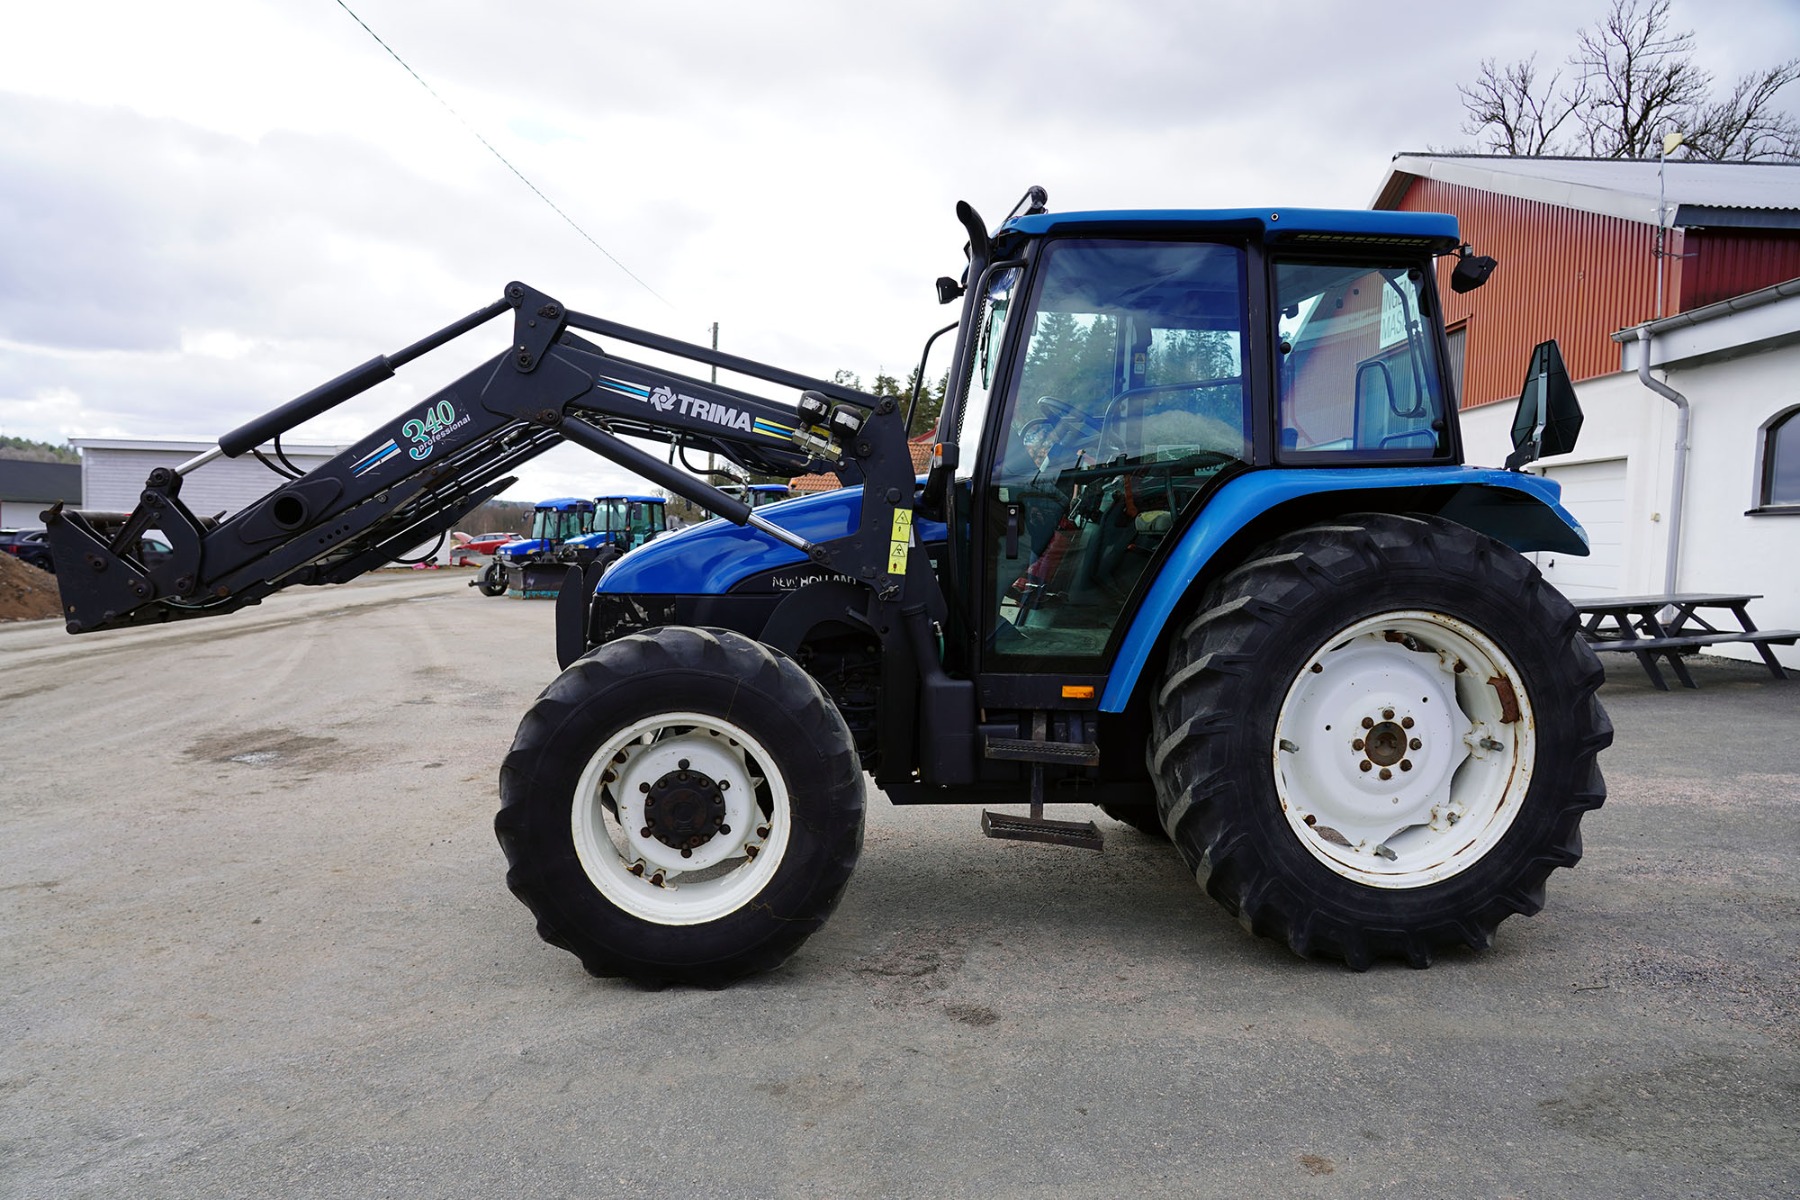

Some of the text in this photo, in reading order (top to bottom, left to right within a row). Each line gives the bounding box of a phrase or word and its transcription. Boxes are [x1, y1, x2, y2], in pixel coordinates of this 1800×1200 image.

[402, 400, 455, 460] 340
[418, 414, 471, 452] professional
[677, 394, 752, 433] TRIMA
